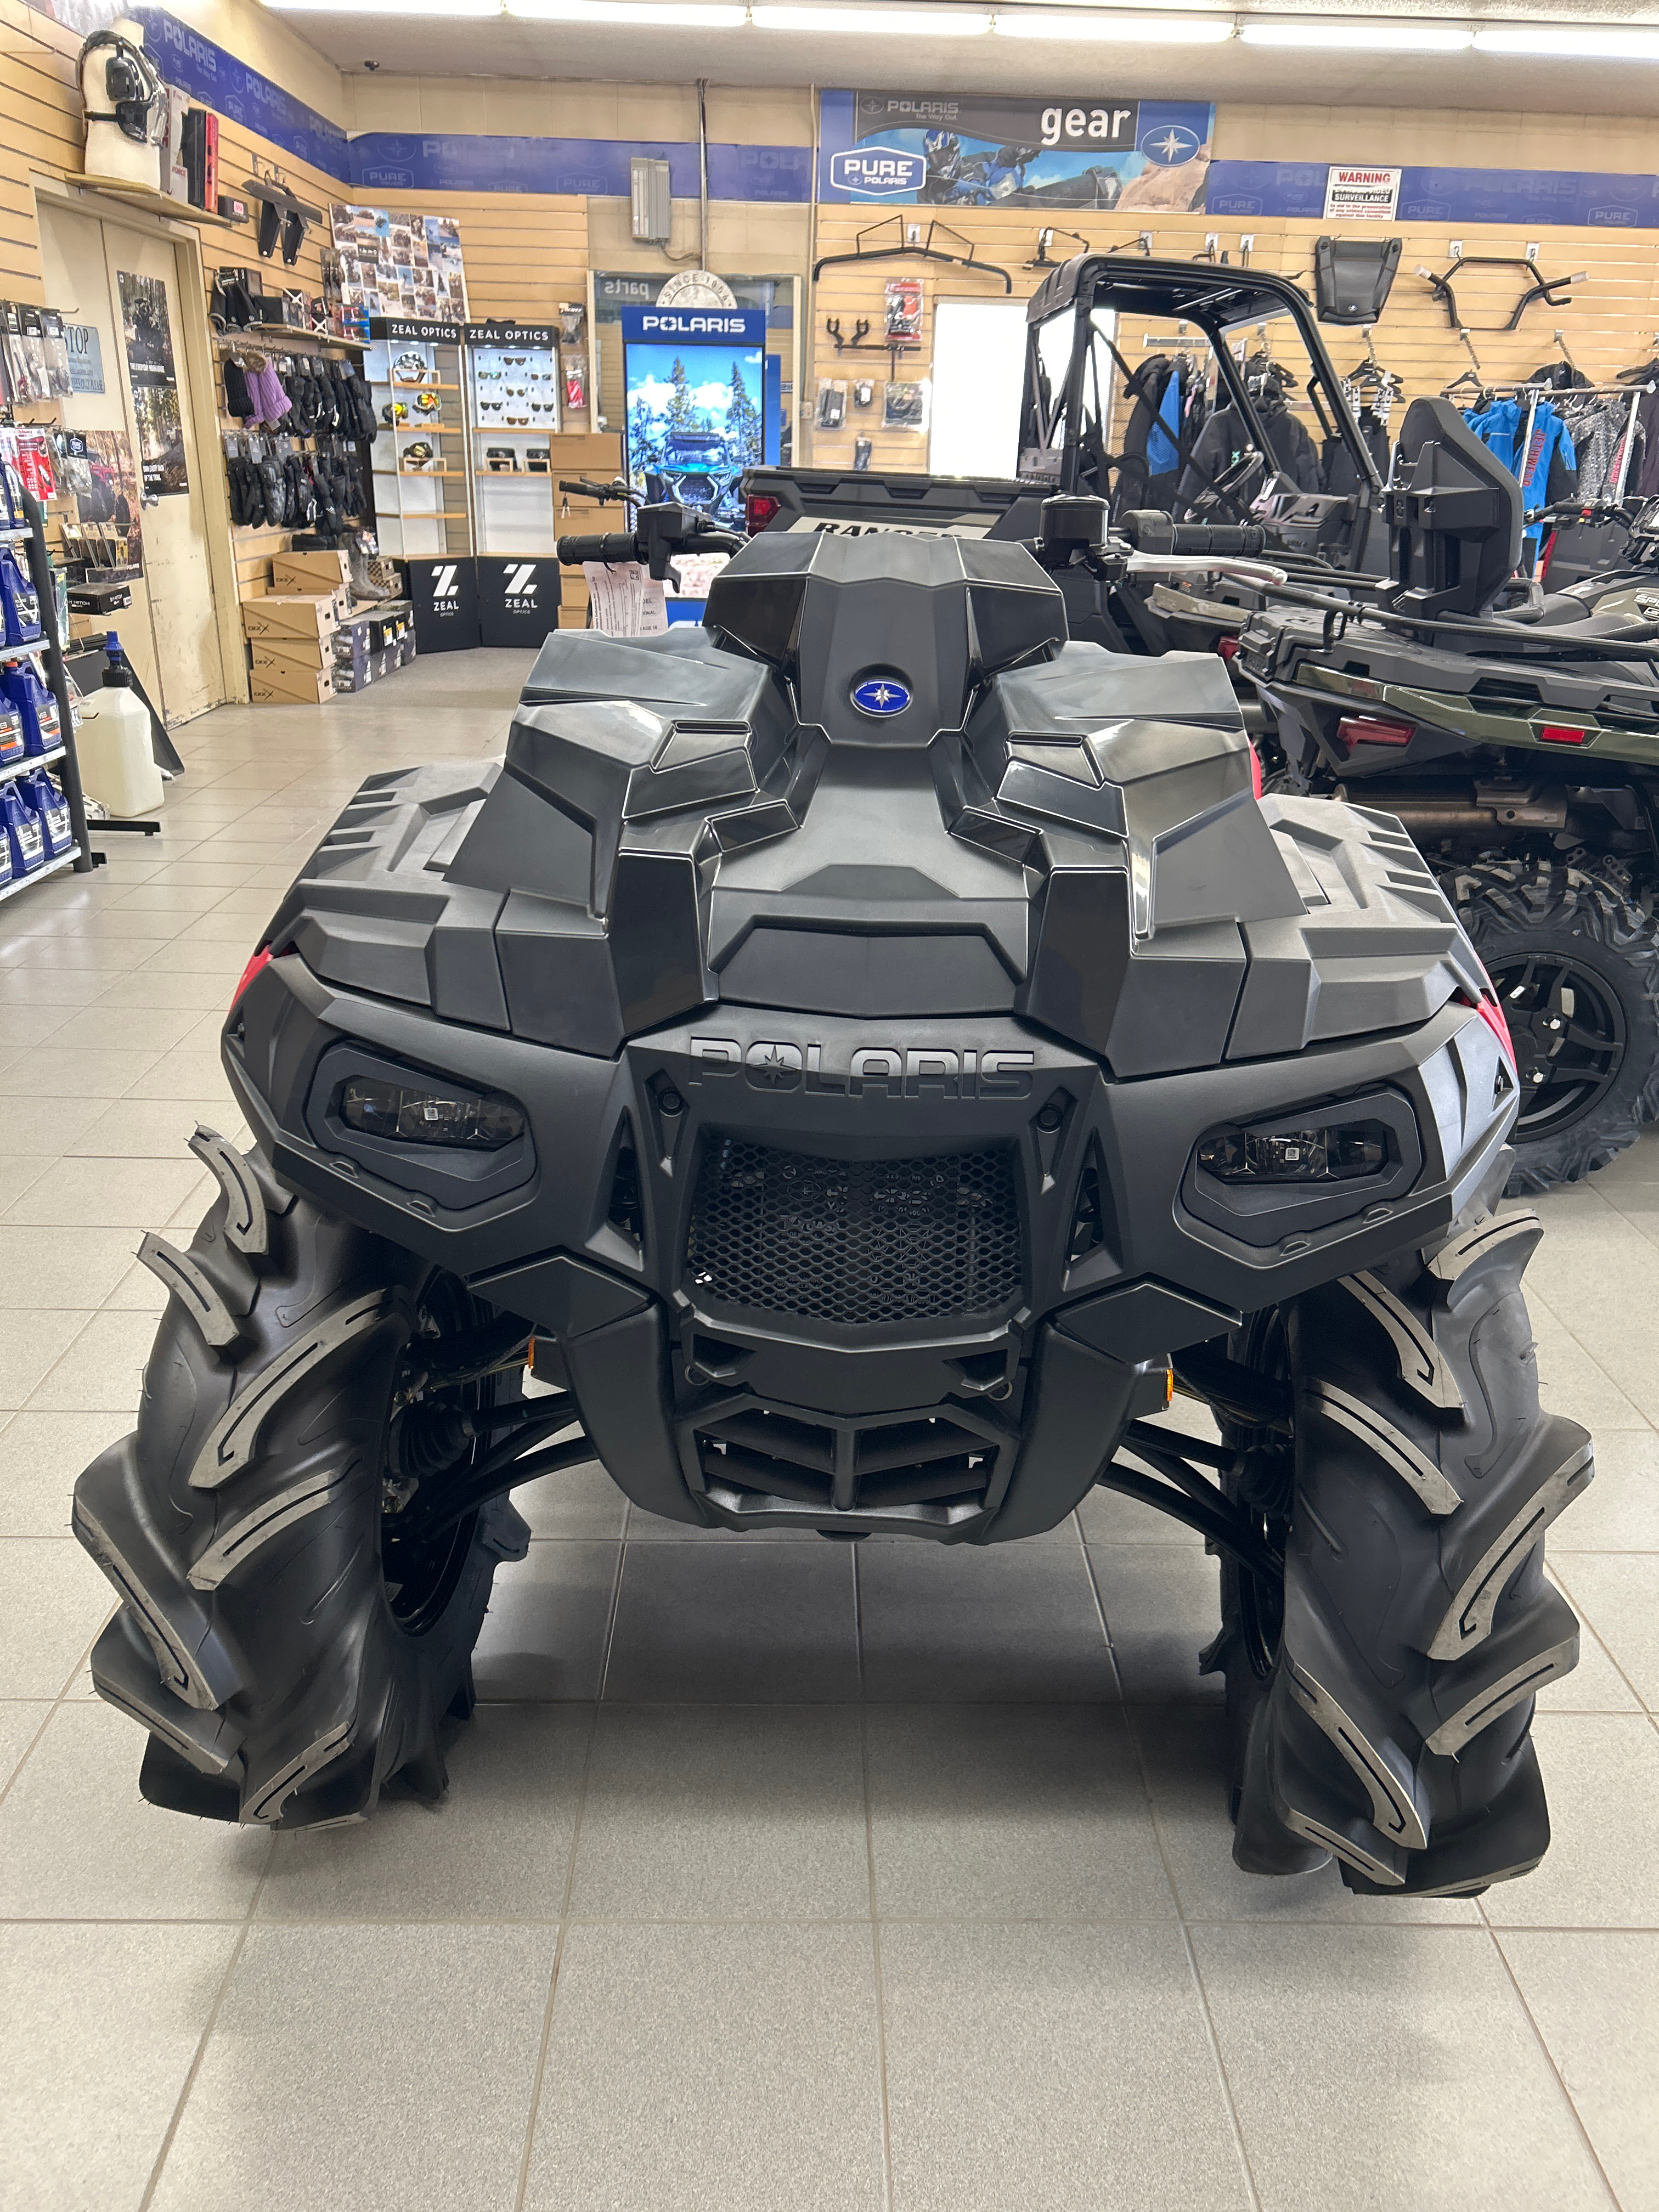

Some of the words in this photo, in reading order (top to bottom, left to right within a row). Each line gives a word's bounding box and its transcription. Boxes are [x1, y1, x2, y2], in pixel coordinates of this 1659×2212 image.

[163, 18, 217, 72] POLARIS
[246, 72, 286, 116] POLARIS
[887, 100, 959, 114] POLARIS
[1041, 108, 1131, 145] gear
[172, 166, 186, 177] FORCE
[844, 159, 913, 176] PURE
[369, 171, 407, 181] PURE
[1339, 172, 1391, 183] WARNING
[563, 178, 600, 188] PURE
[1334, 193, 1389, 202] SURVEILLANCE
[1219, 200, 1256, 209] PURE
[1408, 206, 1444, 215] PURE
[1595, 211, 1631, 221] PURE
[663, 274, 698, 299] SINCE
[642, 316, 746, 332] POLARIS
[392, 324, 418, 335] ZEAL
[421, 326, 456, 338] OPTICS
[470, 329, 500, 340] ZEAL
[505, 331, 549, 341] OPTICS
[814, 522, 962, 538] RAN
[433, 600, 459, 612] ZEAL
[505, 599, 538, 608] ZEAL
[689, 1036, 1036, 1100] POLARIS
